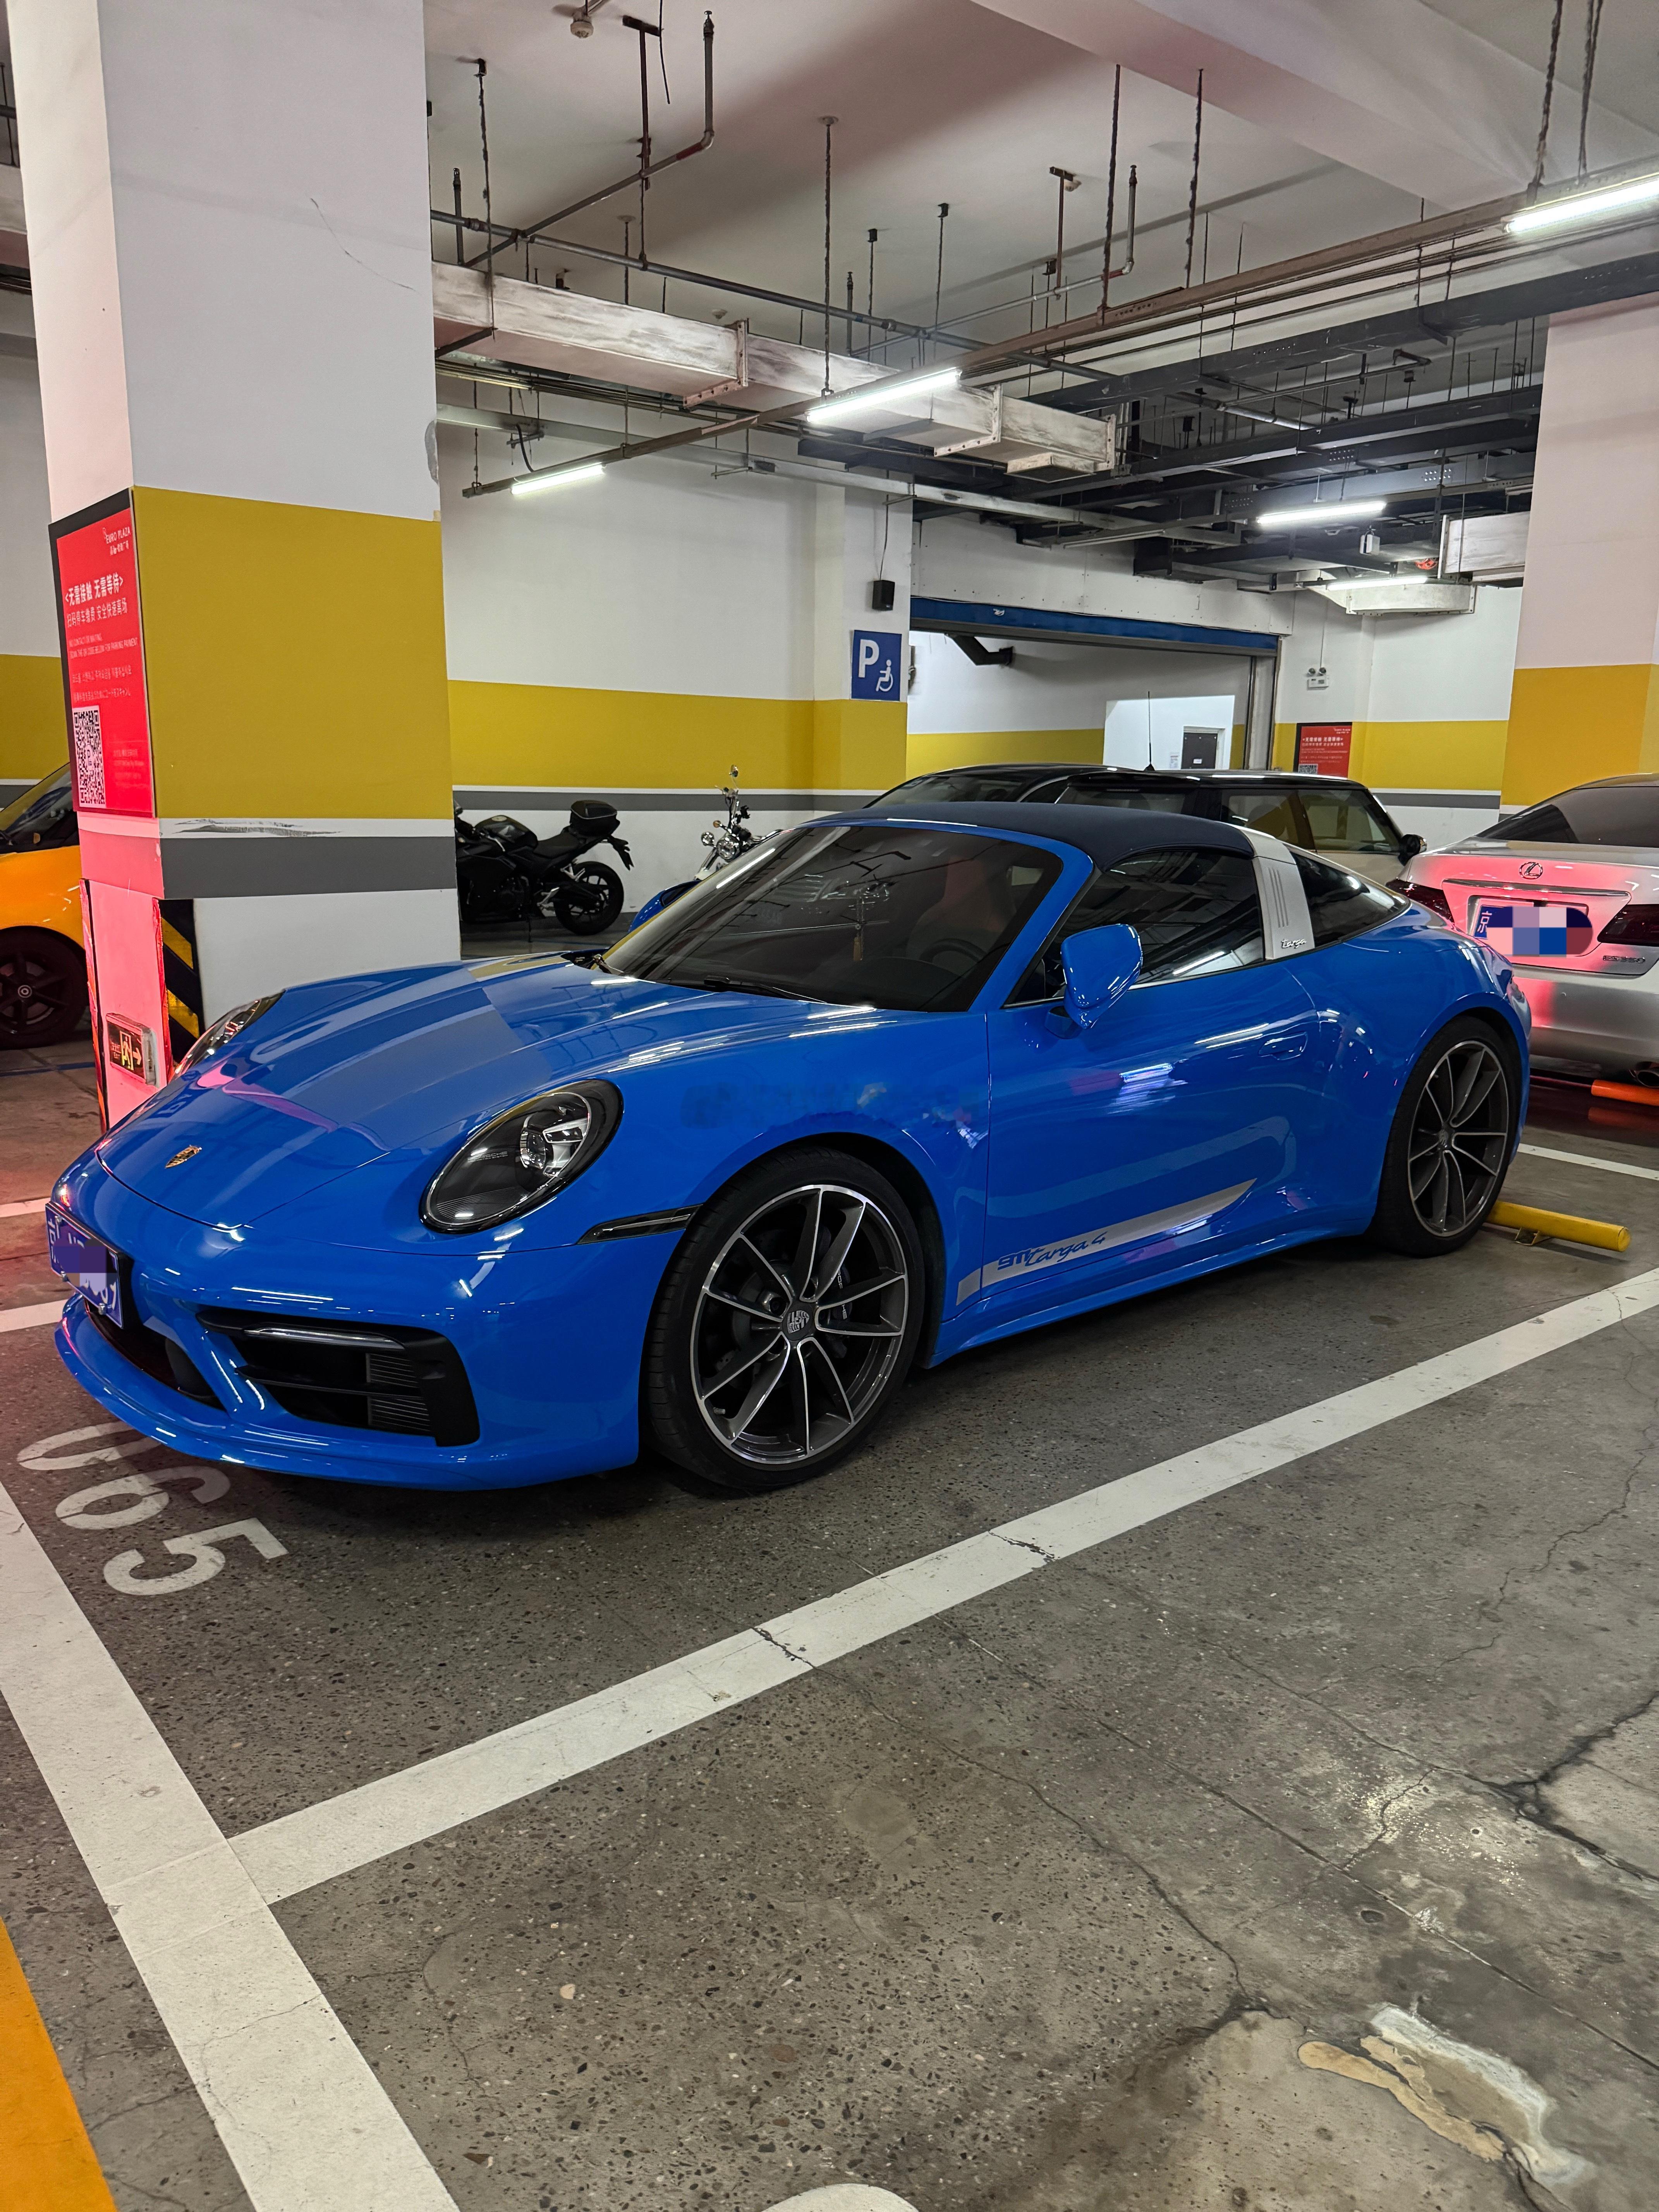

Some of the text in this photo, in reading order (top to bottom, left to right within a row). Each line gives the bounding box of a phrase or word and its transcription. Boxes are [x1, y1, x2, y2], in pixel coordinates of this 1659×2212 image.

[106, 527, 131, 544] EURO PLAZA
[858, 639, 879, 678] P
[1091, 1231, 1108, 1245] 4
